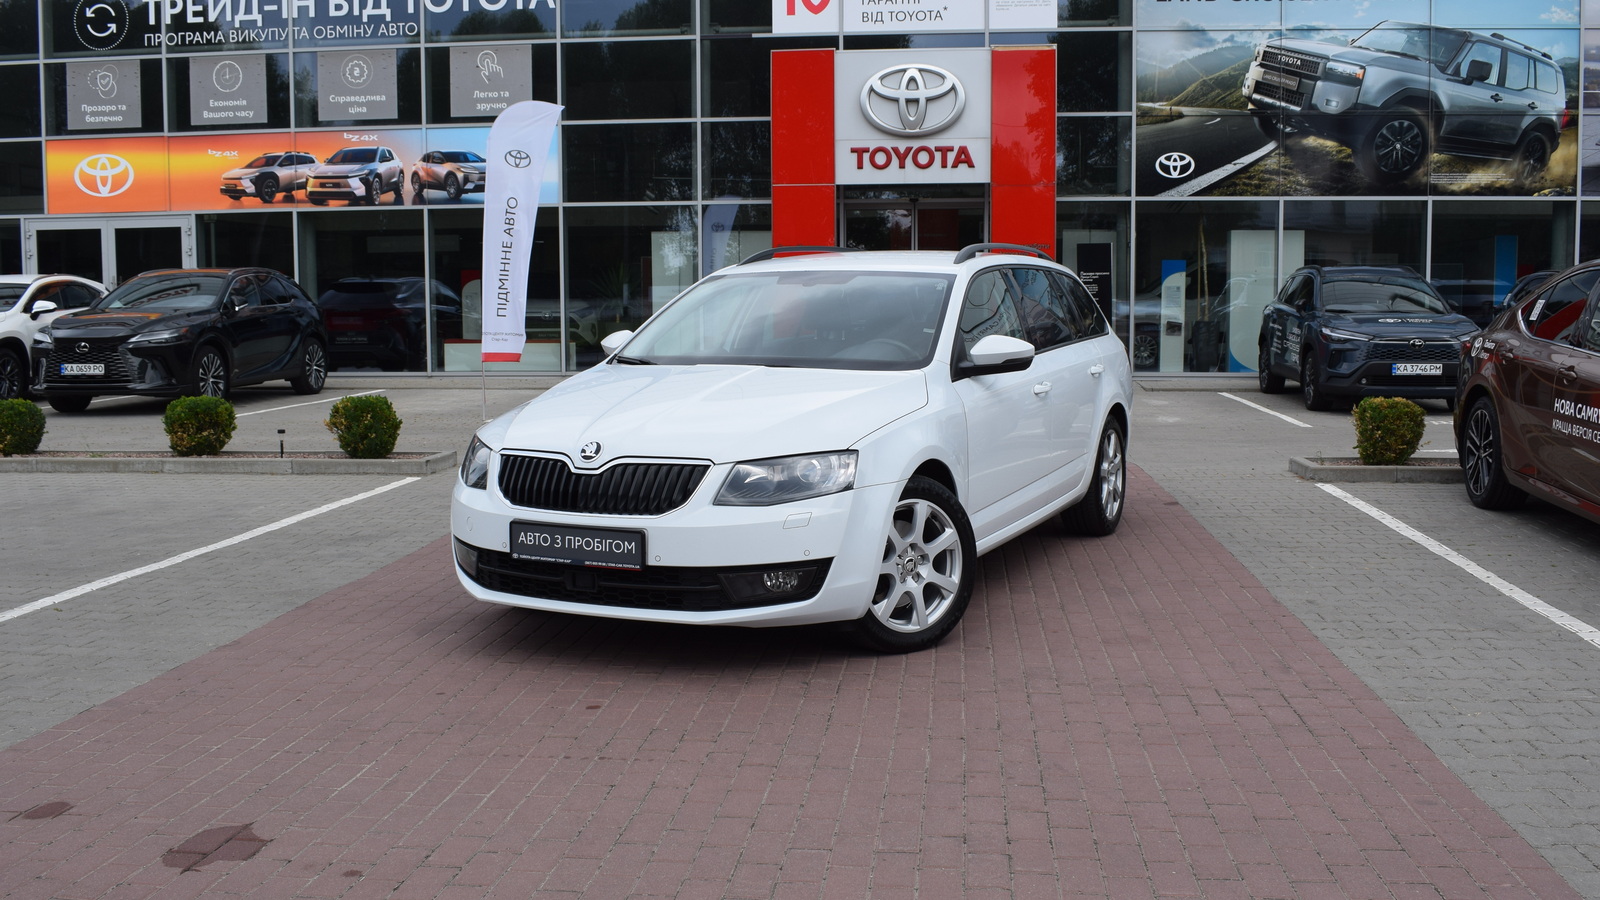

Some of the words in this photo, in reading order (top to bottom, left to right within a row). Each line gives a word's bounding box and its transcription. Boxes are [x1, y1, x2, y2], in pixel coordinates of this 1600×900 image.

[861, 11, 885, 24] ВІД
[144, 30, 225, 46] ПРОГРАМА
[229, 27, 289, 43] ВИКУПУ
[292, 26, 310, 40] ТА
[313, 24, 374, 39] ОБМІНУ
[378, 22, 418, 37] АВТО
[1277, 55, 1301, 66] TOYOTA
[329, 94, 386, 104] Справедлива
[473, 91, 498, 99] Легко
[209, 98, 247, 107] Економія
[476, 102, 508, 111] зручно
[81, 104, 117, 113] Прозоро
[348, 105, 367, 114] ціна
[85, 114, 123, 123] безпечно
[203, 110, 234, 119] Вашого
[235, 110, 254, 119] часу
[850, 145, 976, 171] TOYOTA
[503, 197, 519, 238] АВТО
[497, 241, 513, 317] ПІДМІННЕ
[1396, 364, 1408, 372] KA
[1409, 364, 1428, 372] 3746
[1429, 364, 1441, 372] PM
[1554, 398, 1575, 417] НОВА
[1552, 418, 1571, 436] КРАЩА
[1572, 424, 1593, 440] ВЕРСІЯ
[518, 531, 551, 547] АВТО
[565, 535, 636, 554] ПРОБІГОМ
